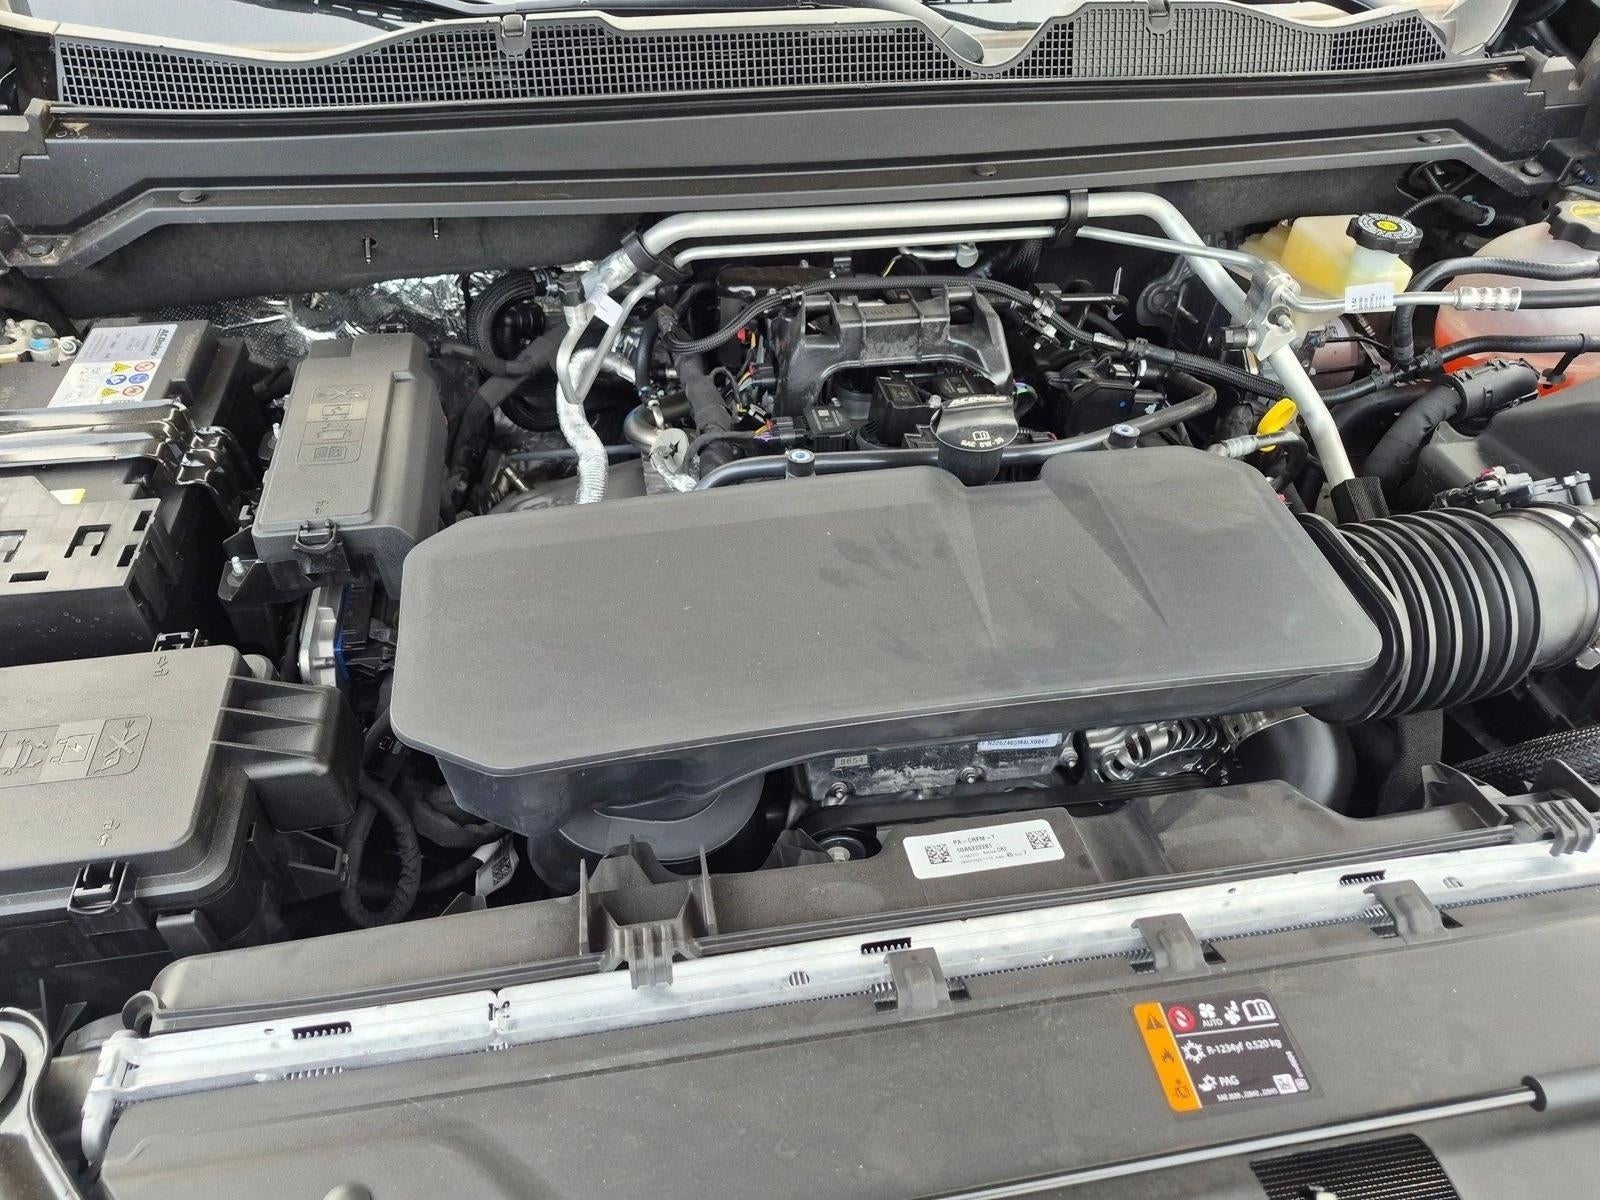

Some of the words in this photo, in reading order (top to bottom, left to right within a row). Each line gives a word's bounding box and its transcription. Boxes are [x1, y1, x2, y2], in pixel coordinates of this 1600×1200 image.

[1202, 1018, 1223, 1028] AUTO
[1206, 1041, 1244, 1055] R-1234yf
[1245, 1039, 1269, 1051] 0.520
[1268, 1038, 1283, 1049] kg
[1218, 1075, 1240, 1087] PAG
